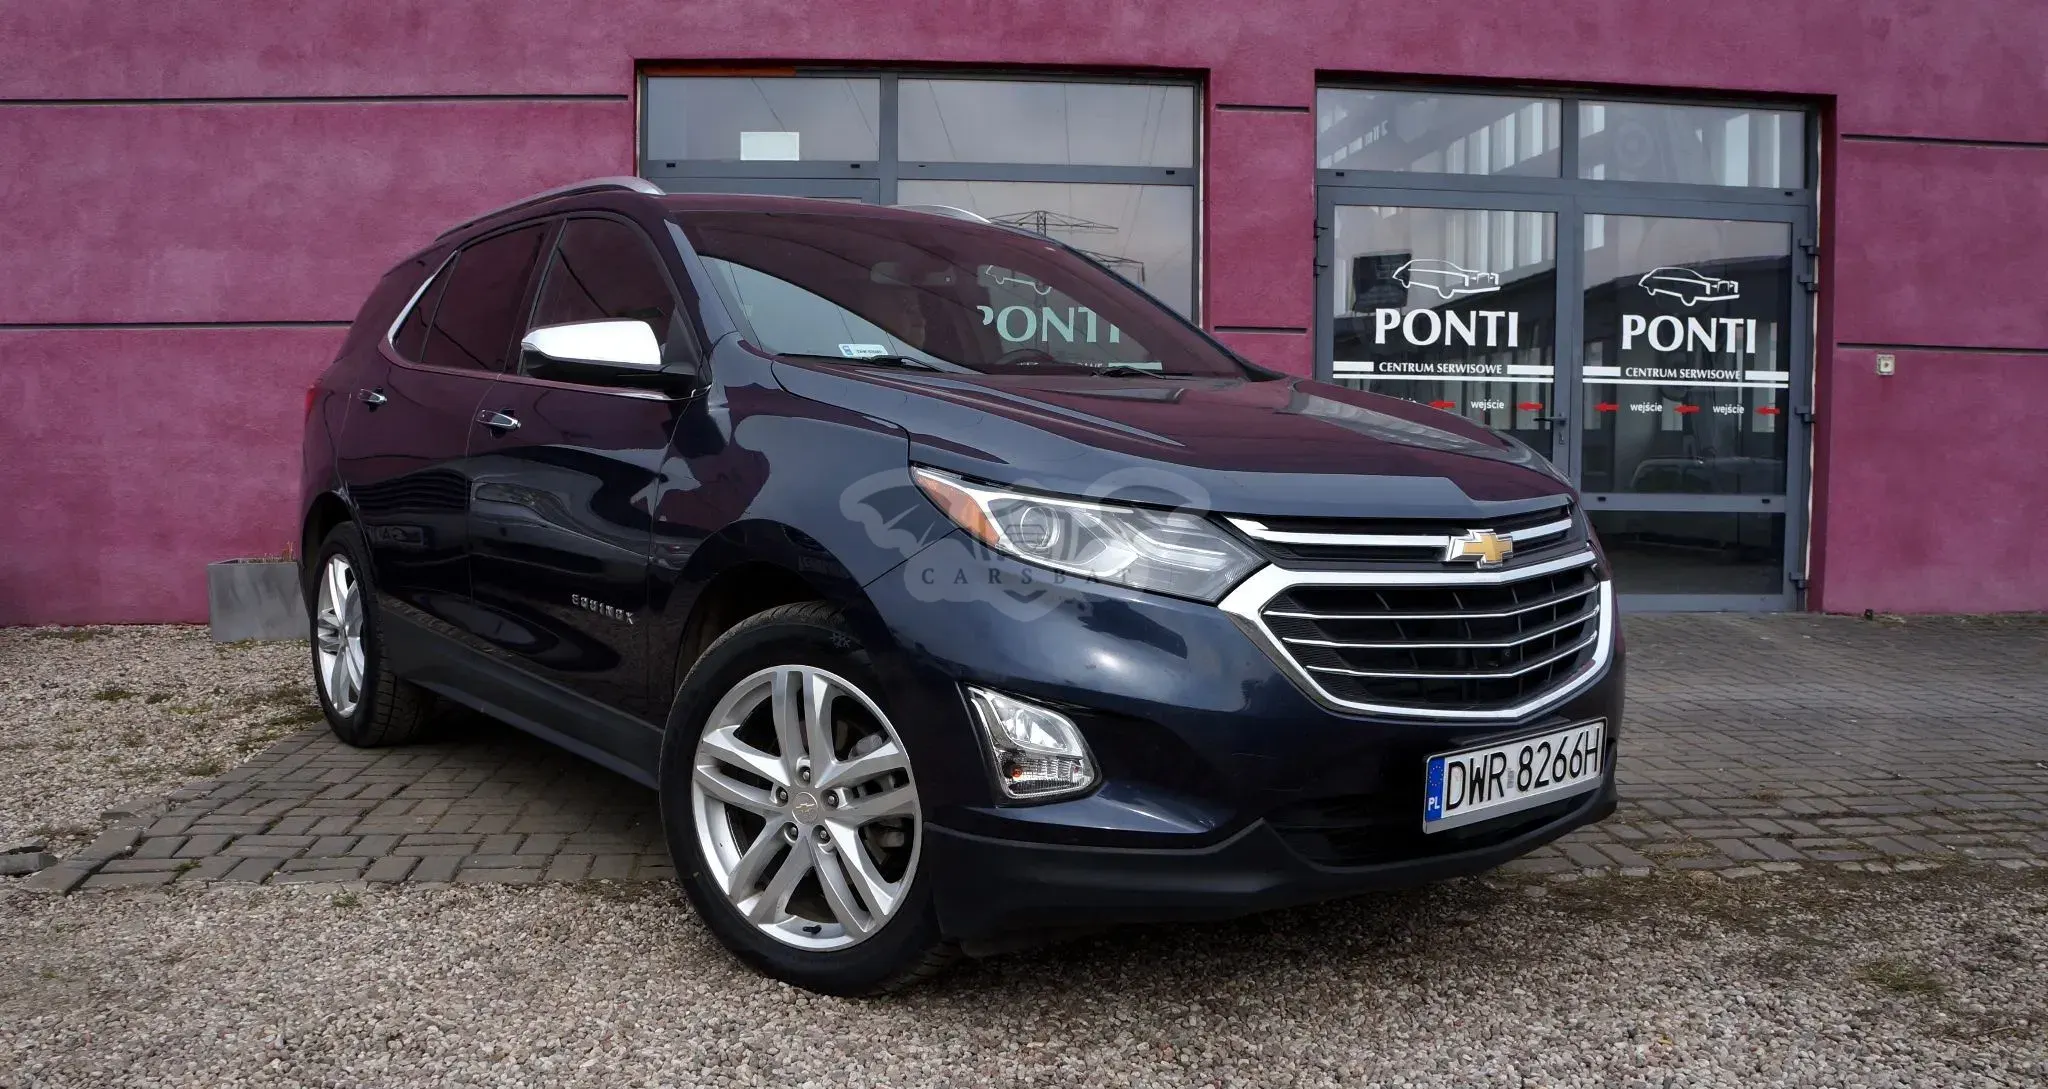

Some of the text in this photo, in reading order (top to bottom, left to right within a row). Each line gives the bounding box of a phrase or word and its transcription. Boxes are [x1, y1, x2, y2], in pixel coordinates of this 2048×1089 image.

[1375, 308, 1519, 347] PONTI
[1621, 314, 1757, 354] PONTI
[1379, 361, 1502, 375] CENTRUM SERWISOWE
[1625, 367, 1741, 380] CENTRUM SERWISOWE
[1470, 398, 1505, 410] wejście
[1630, 401, 1663, 413] wejście
[1713, 402, 1745, 414] wejście
[571, 593, 634, 625] EQUINOX
[1446, 728, 1600, 811] DWR 8266H
[1428, 797, 1440, 811] PL
